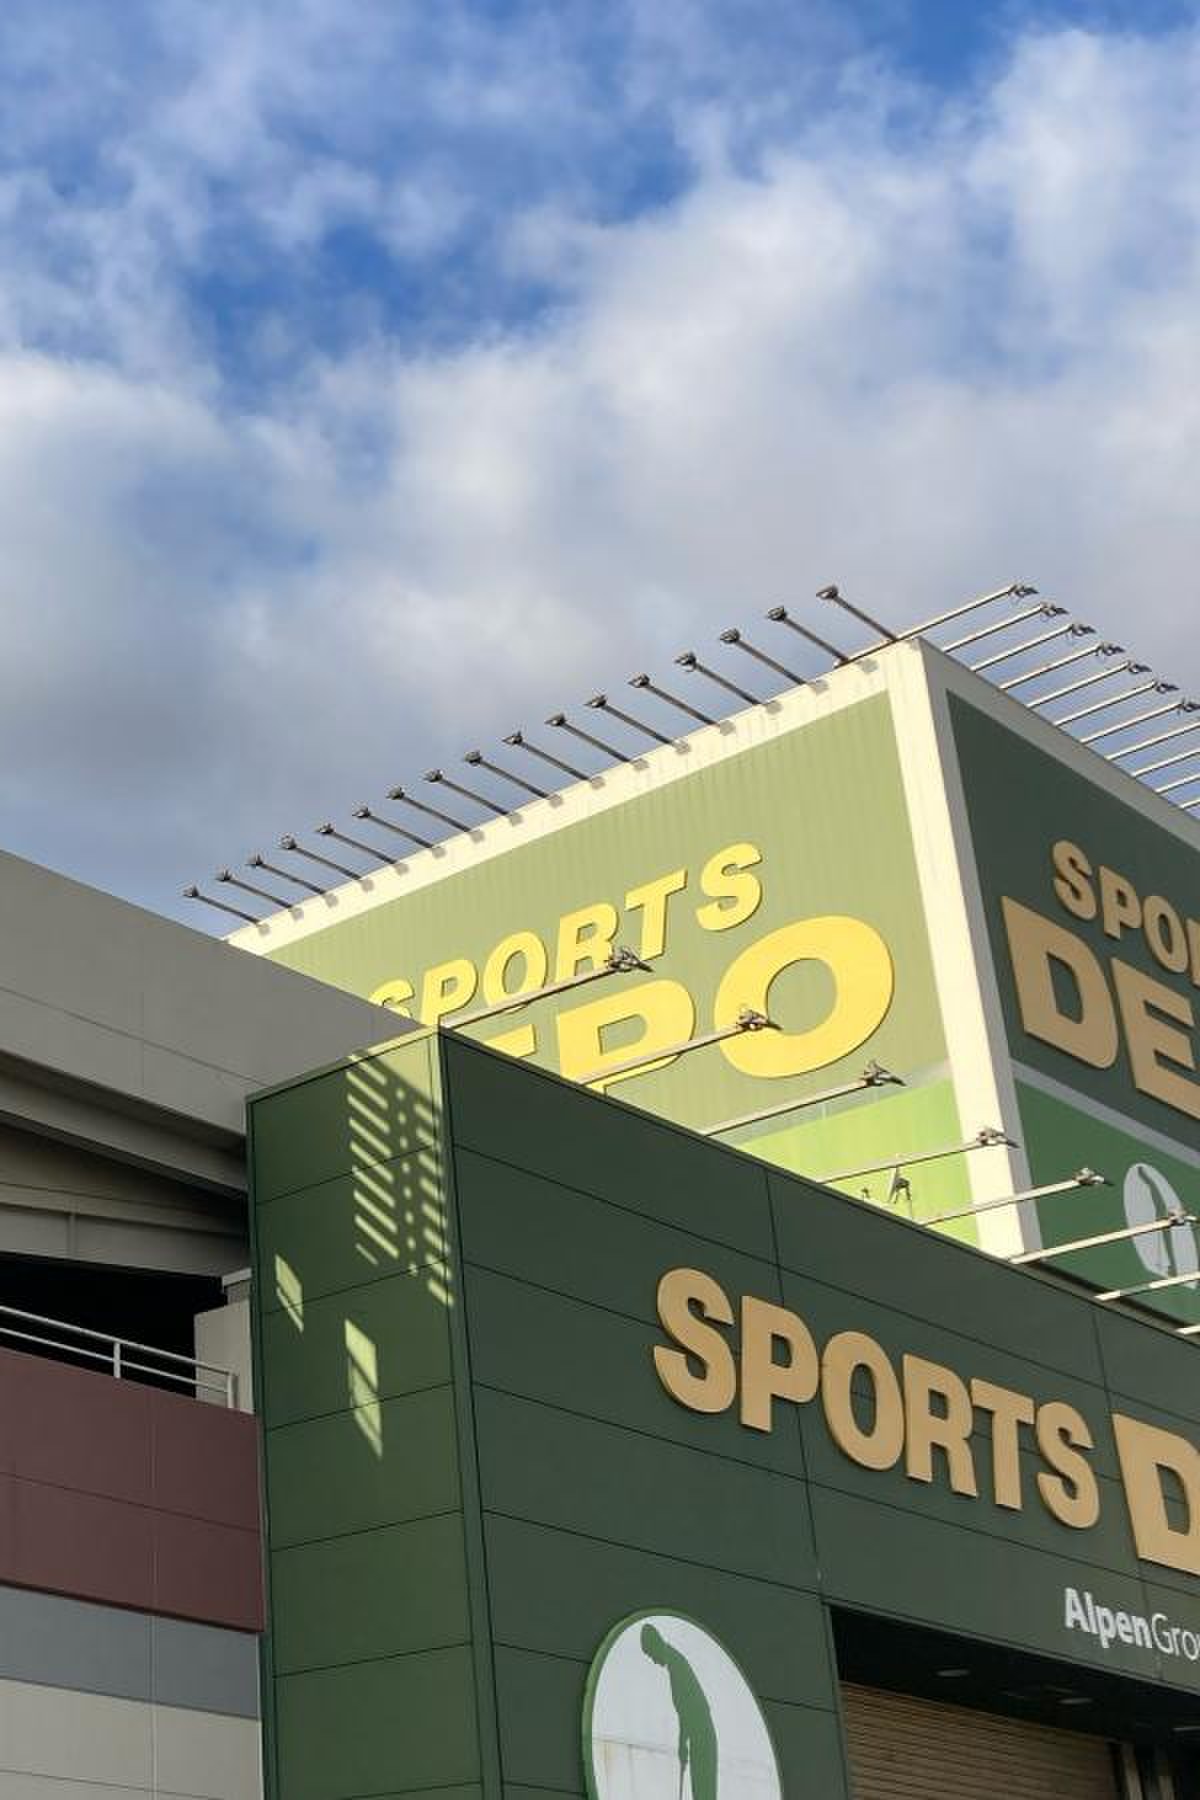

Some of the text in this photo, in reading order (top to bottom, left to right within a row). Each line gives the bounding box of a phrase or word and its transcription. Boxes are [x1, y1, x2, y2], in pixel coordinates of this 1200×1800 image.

[485, 913, 896, 1095] PO
[1002, 895, 1200, 1121] DE
[654, 1266, 1200, 1577] SPORTS D
[1065, 1586, 1200, 1661] AlpenGro
